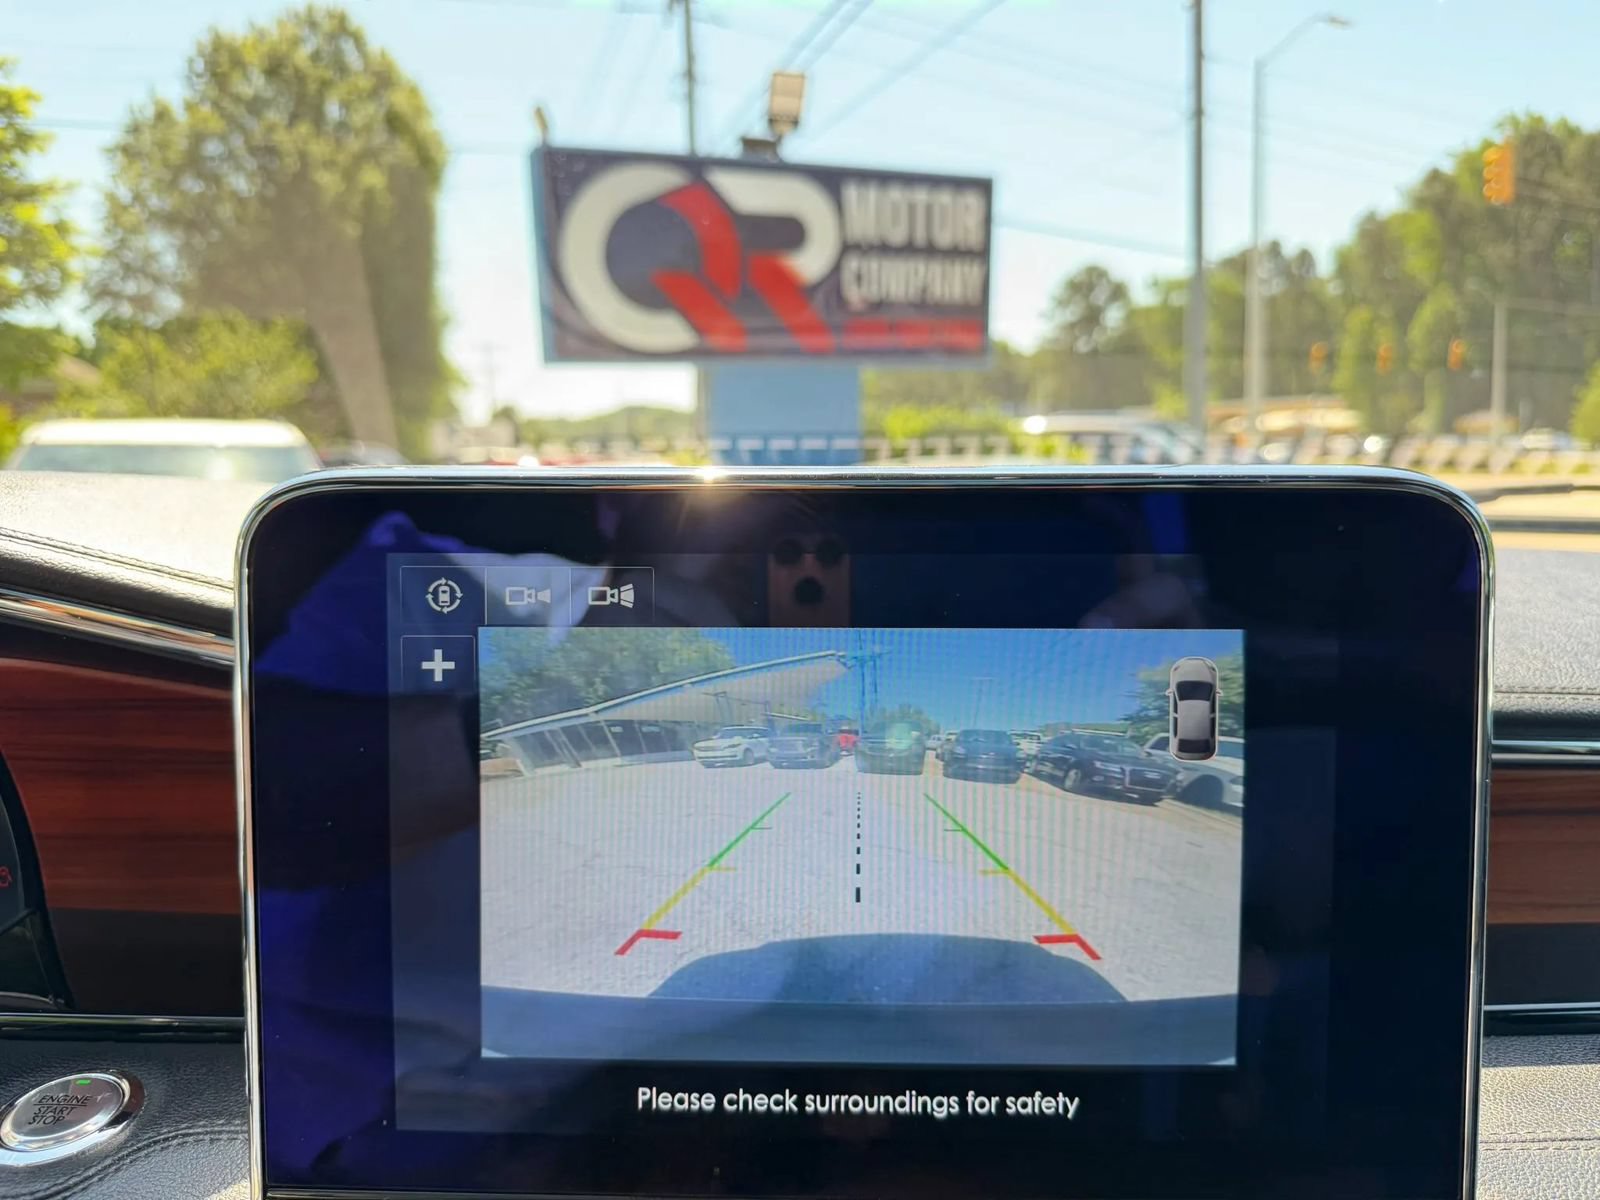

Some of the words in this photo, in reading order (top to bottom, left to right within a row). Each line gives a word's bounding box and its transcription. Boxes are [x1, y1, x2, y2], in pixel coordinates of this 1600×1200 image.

[841, 182, 987, 249] MOTOR
[841, 255, 986, 304] COMPANY
[38, 1094, 93, 1104] ENGINE
[637, 1086, 716, 1111] Please
[723, 1088, 798, 1112] check
[804, 1090, 960, 1119] surroundings
[965, 1090, 999, 1114] for
[1005, 1091, 1079, 1120] safety
[28, 1115, 66, 1125] STOP
[33, 1106, 77, 1116] START
